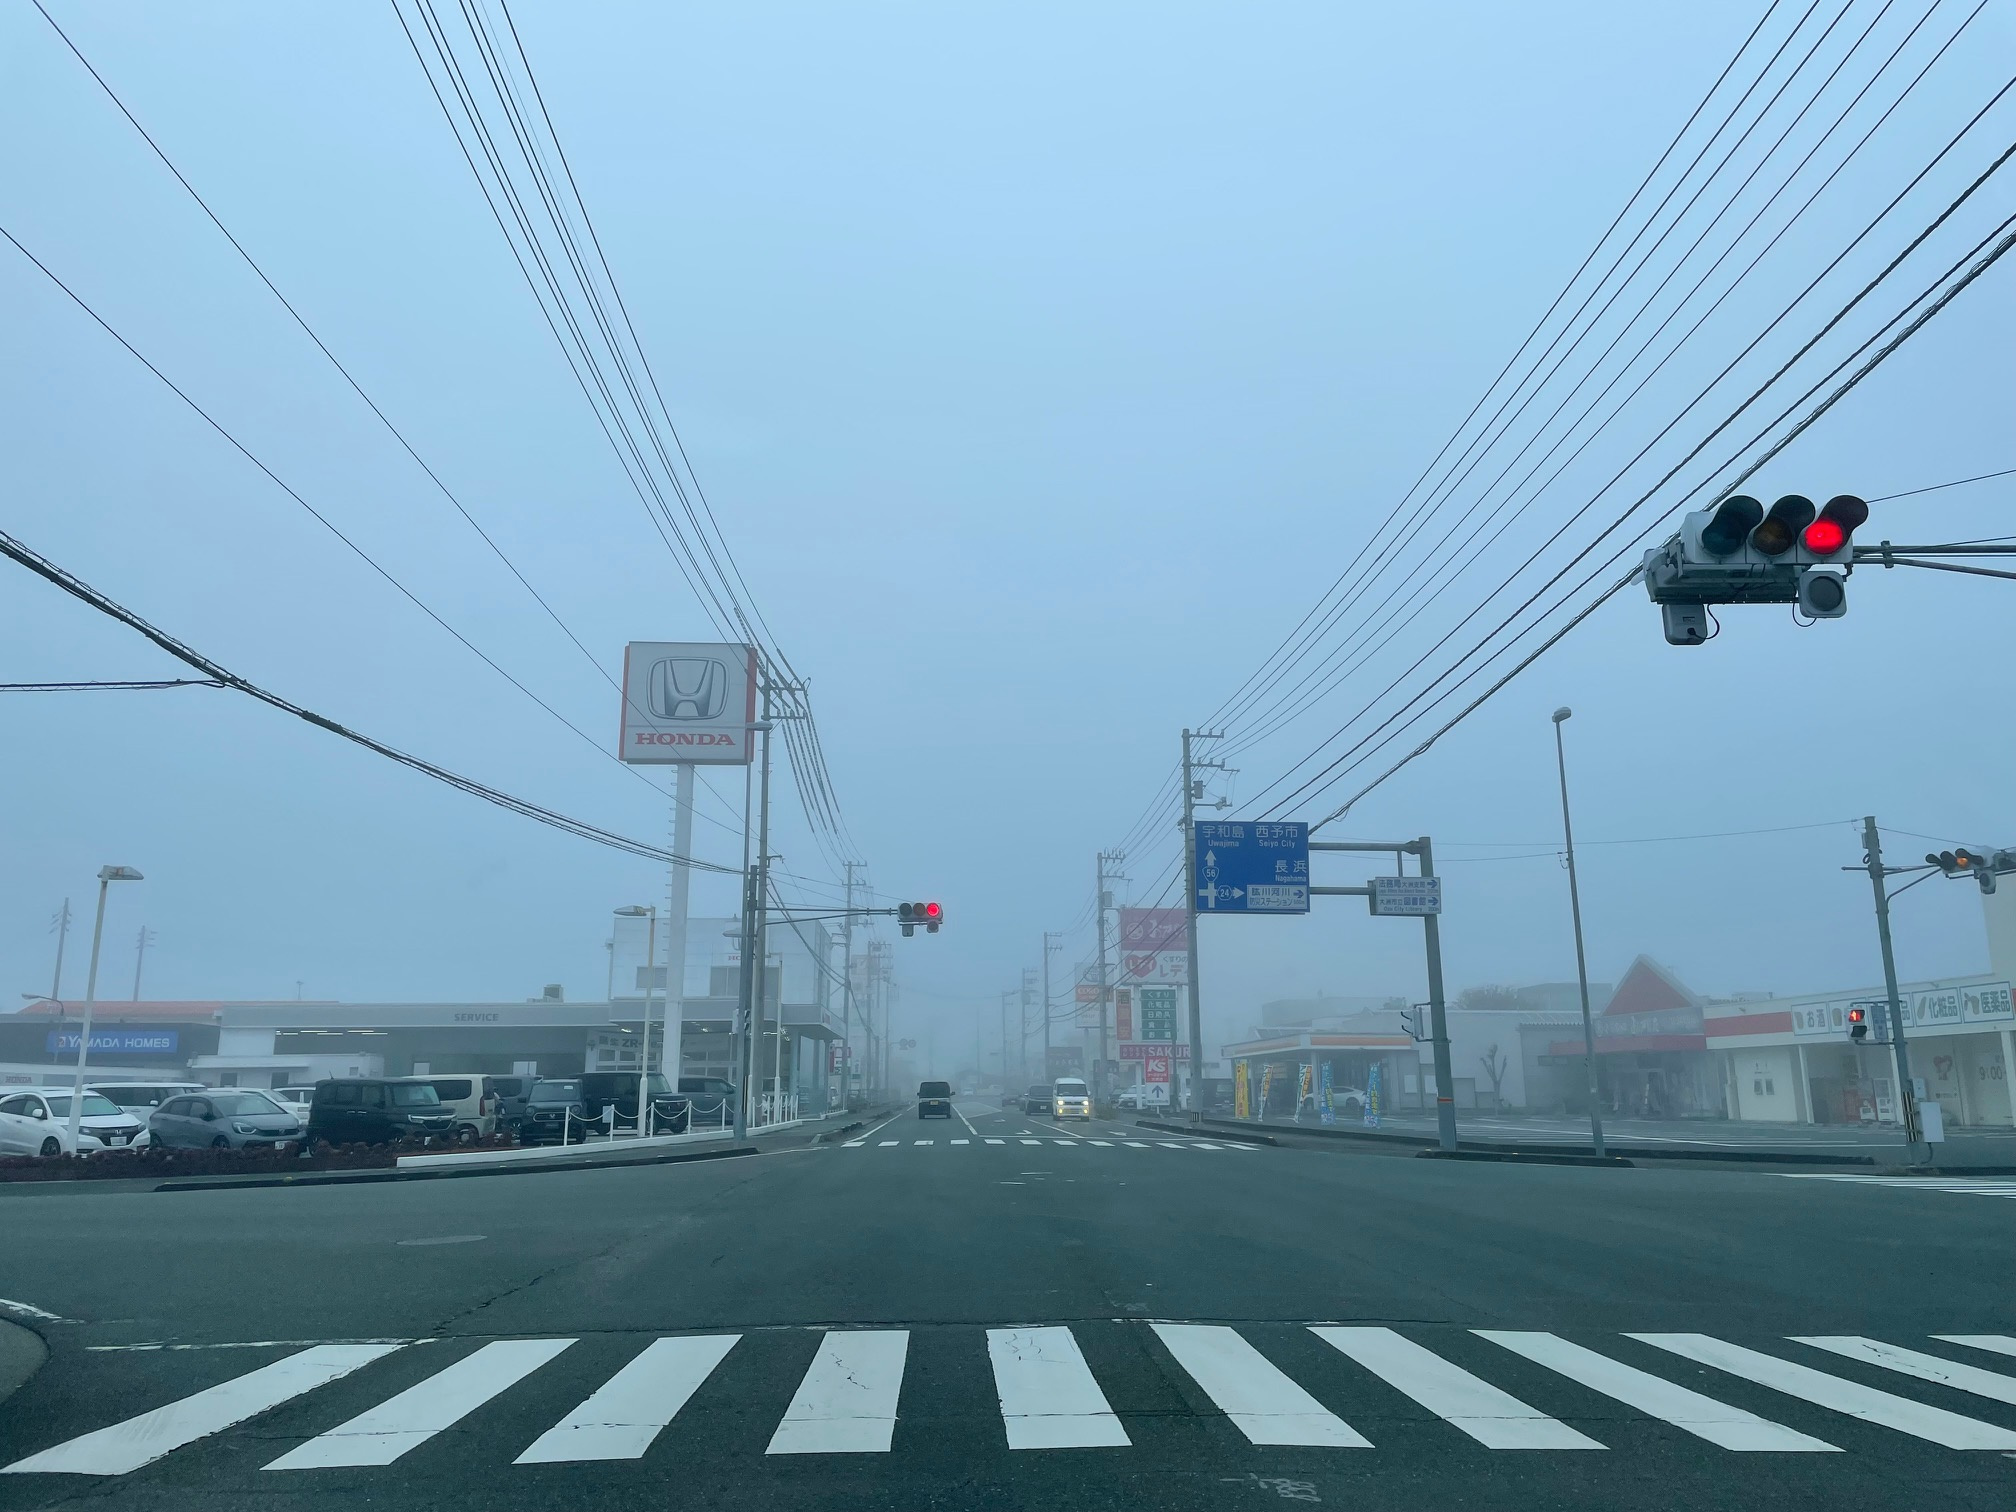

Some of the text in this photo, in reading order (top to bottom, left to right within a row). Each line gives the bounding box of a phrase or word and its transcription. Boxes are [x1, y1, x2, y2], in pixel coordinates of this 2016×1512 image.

[634, 733, 736, 745] HONDA
[1202, 825, 1298, 839] 宇和島 西予市
[1208, 839, 1296, 848] Uwajima Seiyo City
[1275, 859, 1307, 874] 長浜
[1206, 869, 1216, 877] 56
[1275, 875, 1307, 883] Nagahama
[1220, 889, 1229, 897] 24
[1928, 995, 1959, 1019] 化粧品
[1980, 989, 2012, 1013] 医薬品
[454, 1013, 500, 1022] SERVICE
[1806, 1008, 1826, 1028] お酒
[68, 1035, 171, 1048] YAMADA HOMES
[1148, 1046, 1191, 1058] SAKUR
